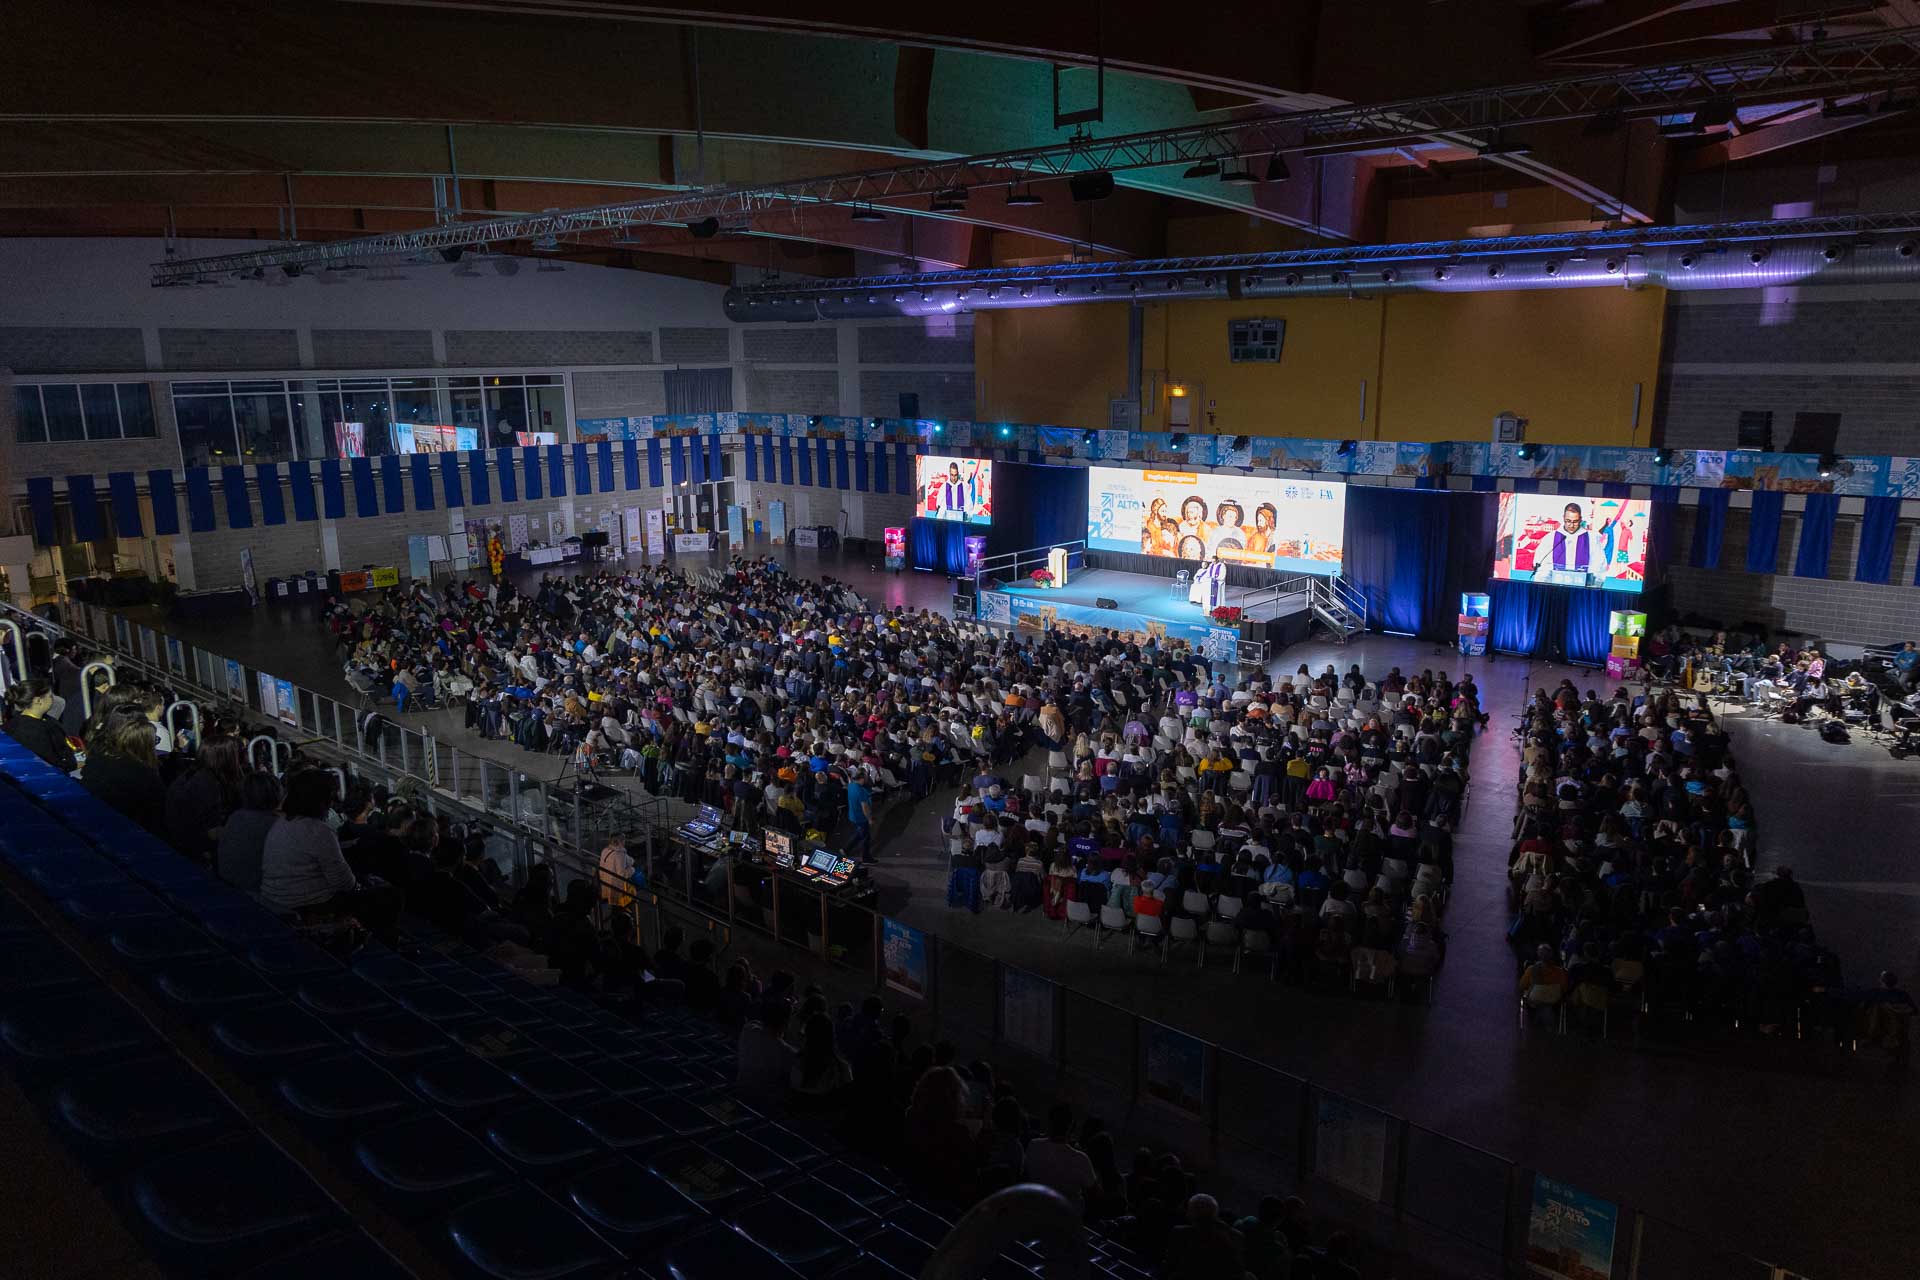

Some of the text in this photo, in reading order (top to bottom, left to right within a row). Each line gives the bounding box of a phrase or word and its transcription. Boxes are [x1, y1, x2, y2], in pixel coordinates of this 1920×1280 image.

[1700, 456, 1723, 464] ALTO
[1853, 464, 1879, 472] ALTO
[1117, 500, 1140, 508] ALTO
